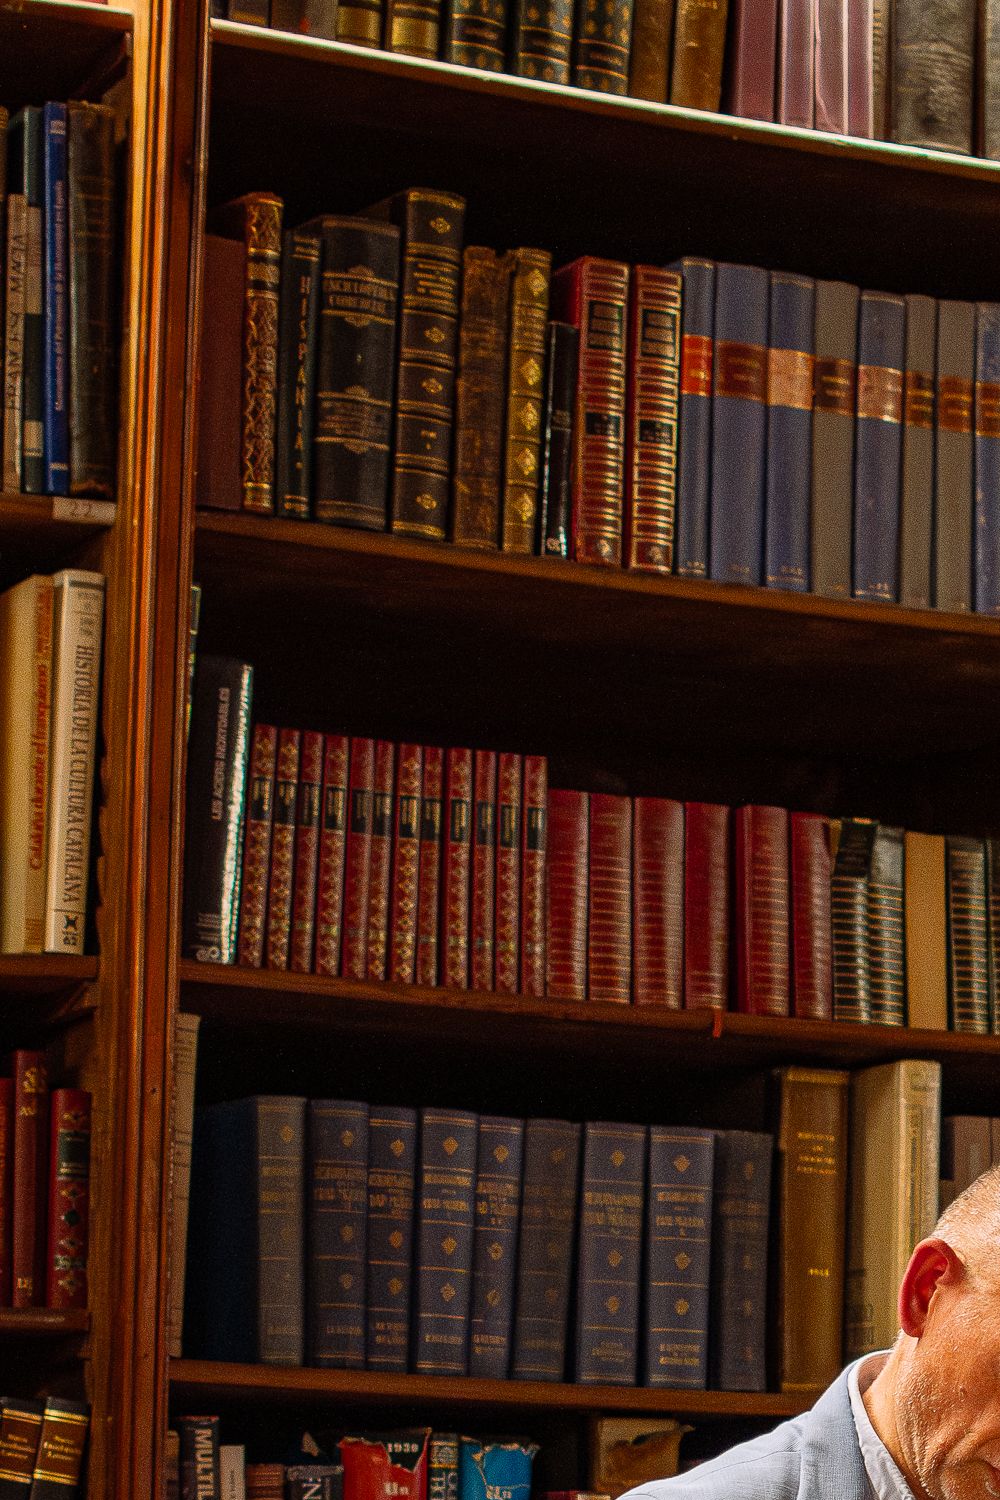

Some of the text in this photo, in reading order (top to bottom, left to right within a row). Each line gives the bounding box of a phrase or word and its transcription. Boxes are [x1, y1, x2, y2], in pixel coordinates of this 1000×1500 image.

[34, 664, 51, 740] franquismo
[71, 716, 91, 736] DE
[33, 741, 46, 756] el
[70, 738, 90, 757] LA
[211, 686, 230, 821] LES ACIERS INOXYDABLES
[32, 757, 46, 808] durante
[66, 759, 89, 827] CULTURA
[62, 828, 86, 904] CATALANA
[384, 1482, 410, 1496] Un
[485, 1485, 513, 1500] Un
